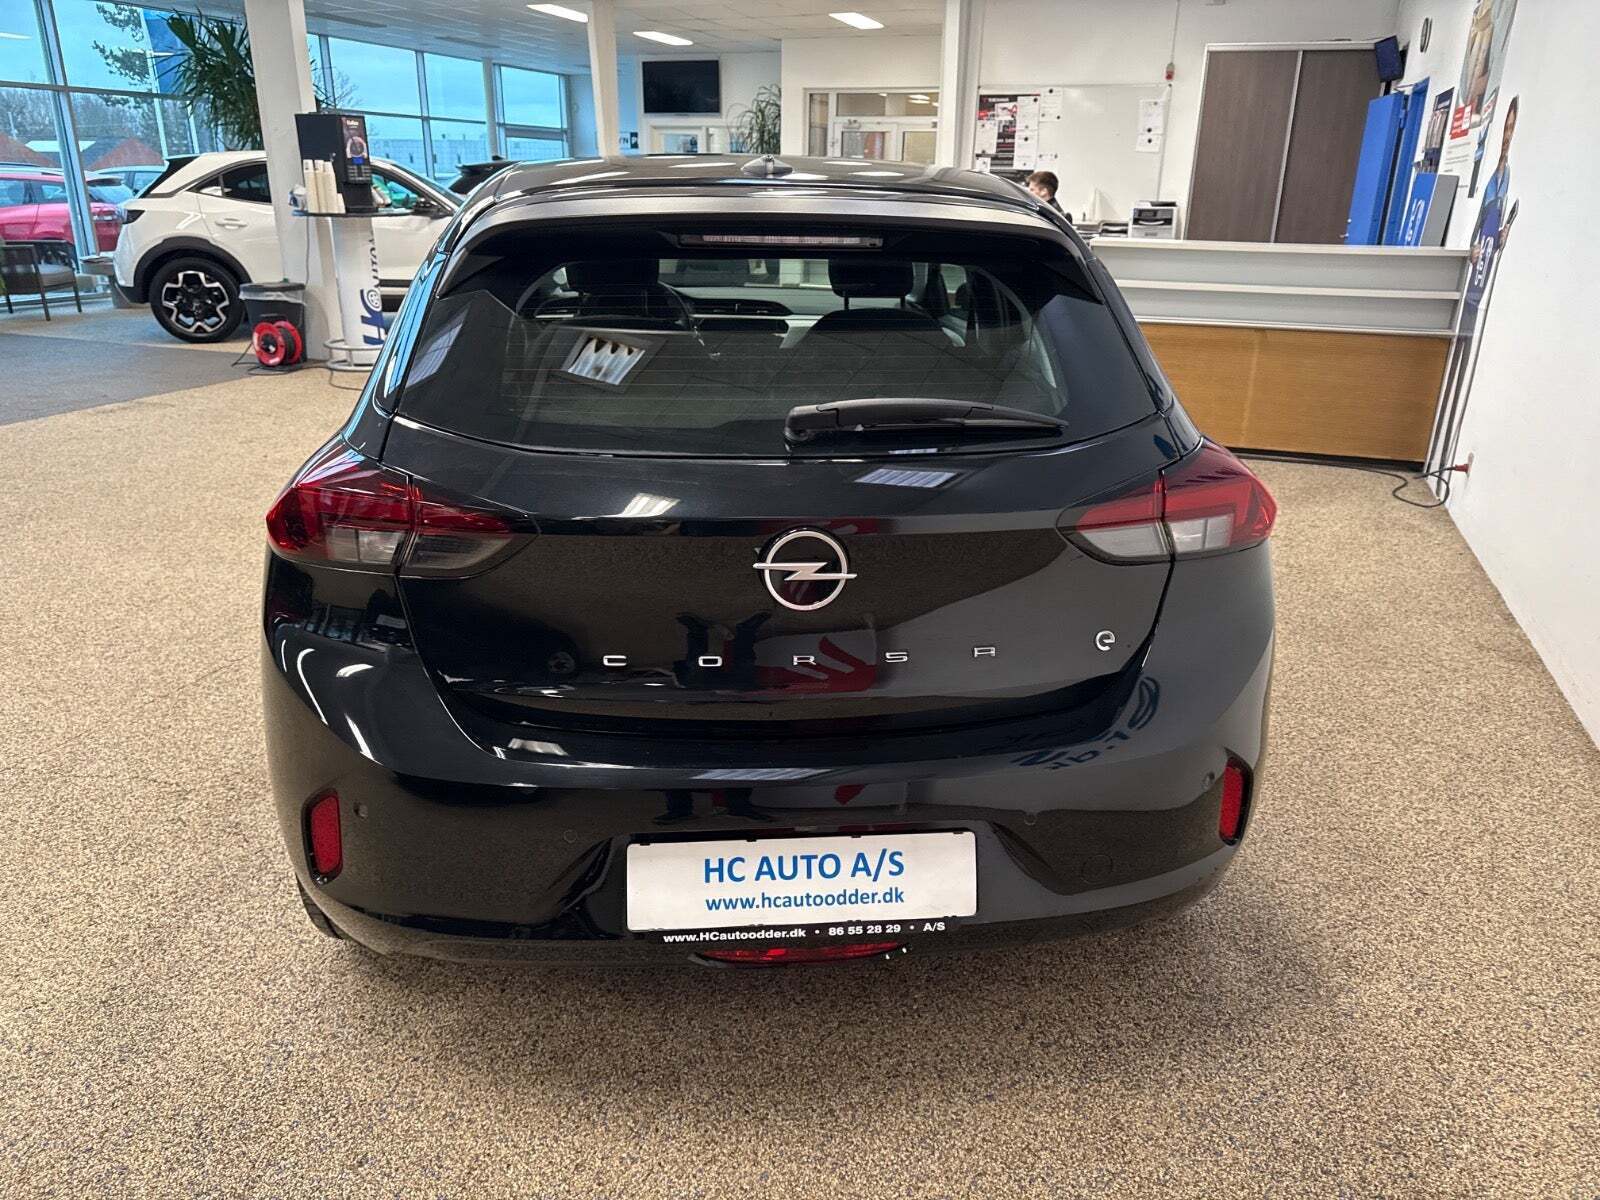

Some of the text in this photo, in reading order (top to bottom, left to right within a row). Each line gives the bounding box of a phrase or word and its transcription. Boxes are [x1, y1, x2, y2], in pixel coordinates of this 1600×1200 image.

[602, 646, 996, 667] CORSA
[704, 848, 905, 884] HC AUTO A/S
[705, 887, 905, 911] www.hcautoodder.dk
[662, 921, 946, 943] www.HCautoodder.dk 86 55 28 29 A/S
